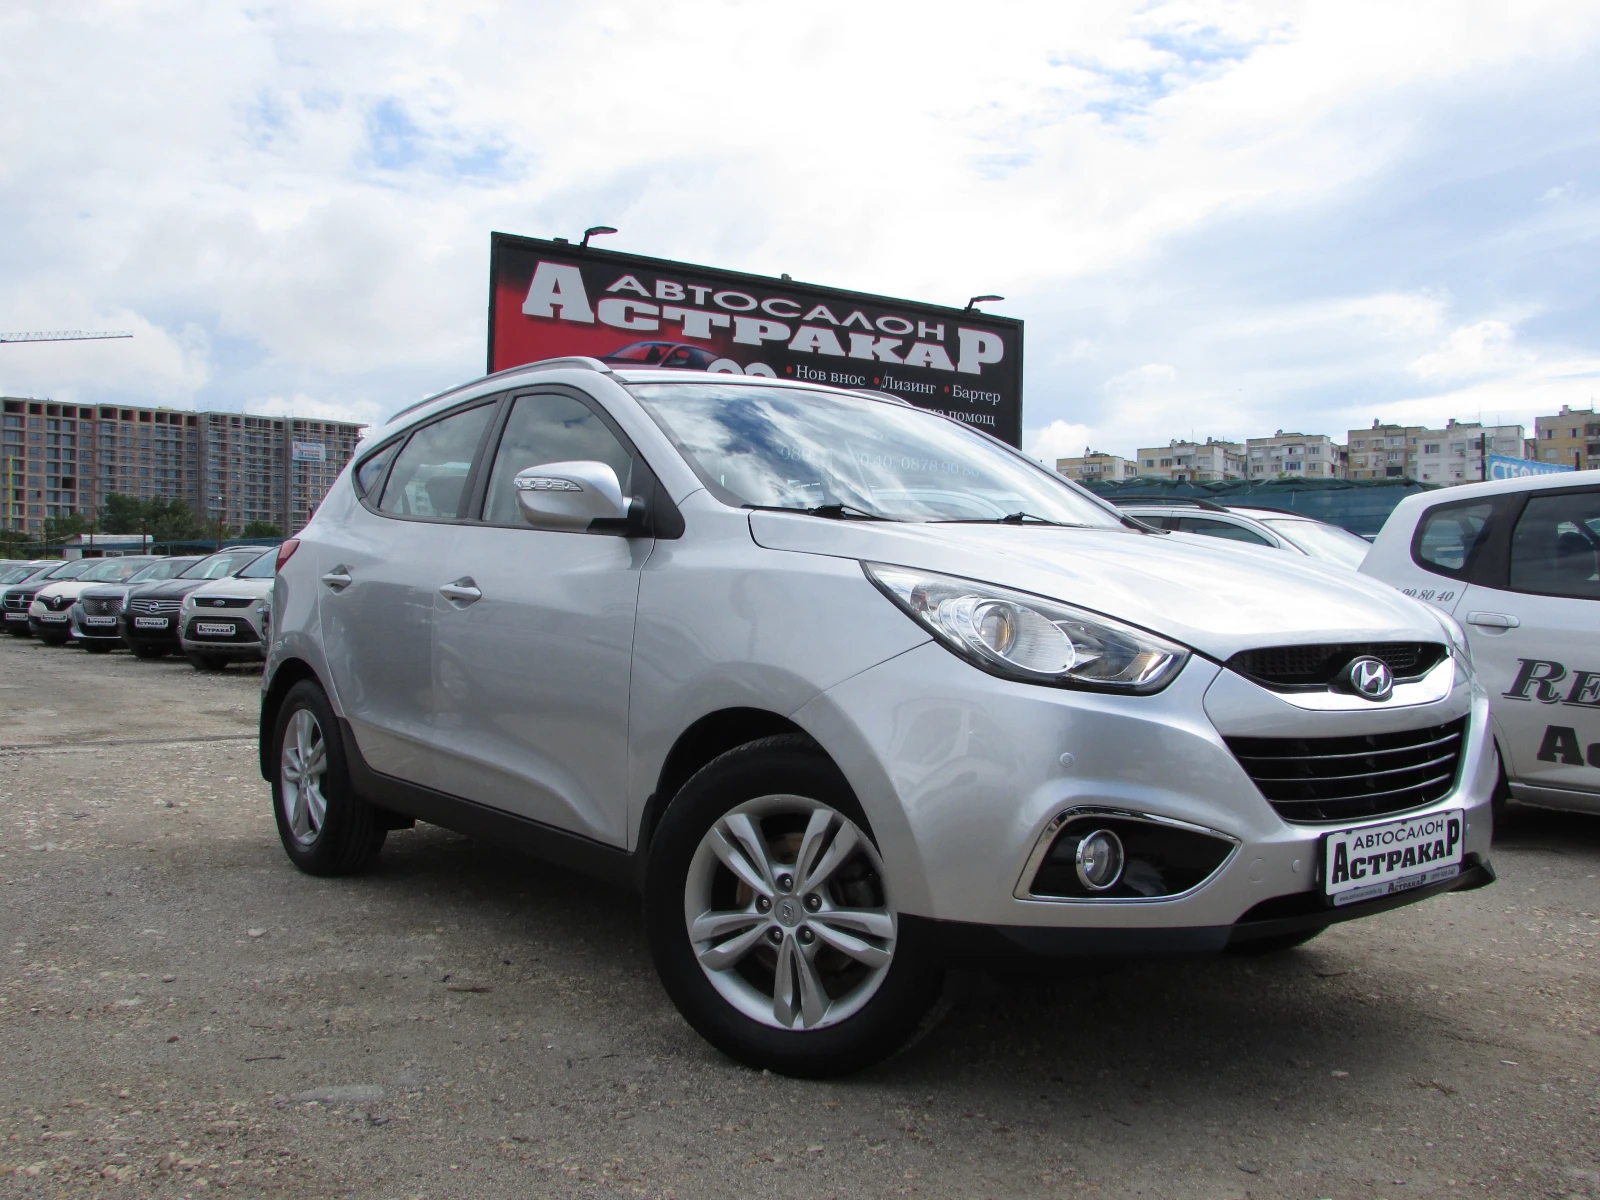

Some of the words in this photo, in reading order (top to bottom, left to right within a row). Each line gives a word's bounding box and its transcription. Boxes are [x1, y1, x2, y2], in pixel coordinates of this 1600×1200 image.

[606, 274, 945, 342] АВТОСАЛОН
[796, 364, 827, 381] Нов
[830, 371, 866, 386] внос
[882, 376, 937, 395] Лизинг
[952, 385, 1001, 405] Бартер
[948, 409, 996, 427] помощ
[1437, 591, 1455, 602] 40
[1353, 819, 1444, 850] АВТОСАЛОН
